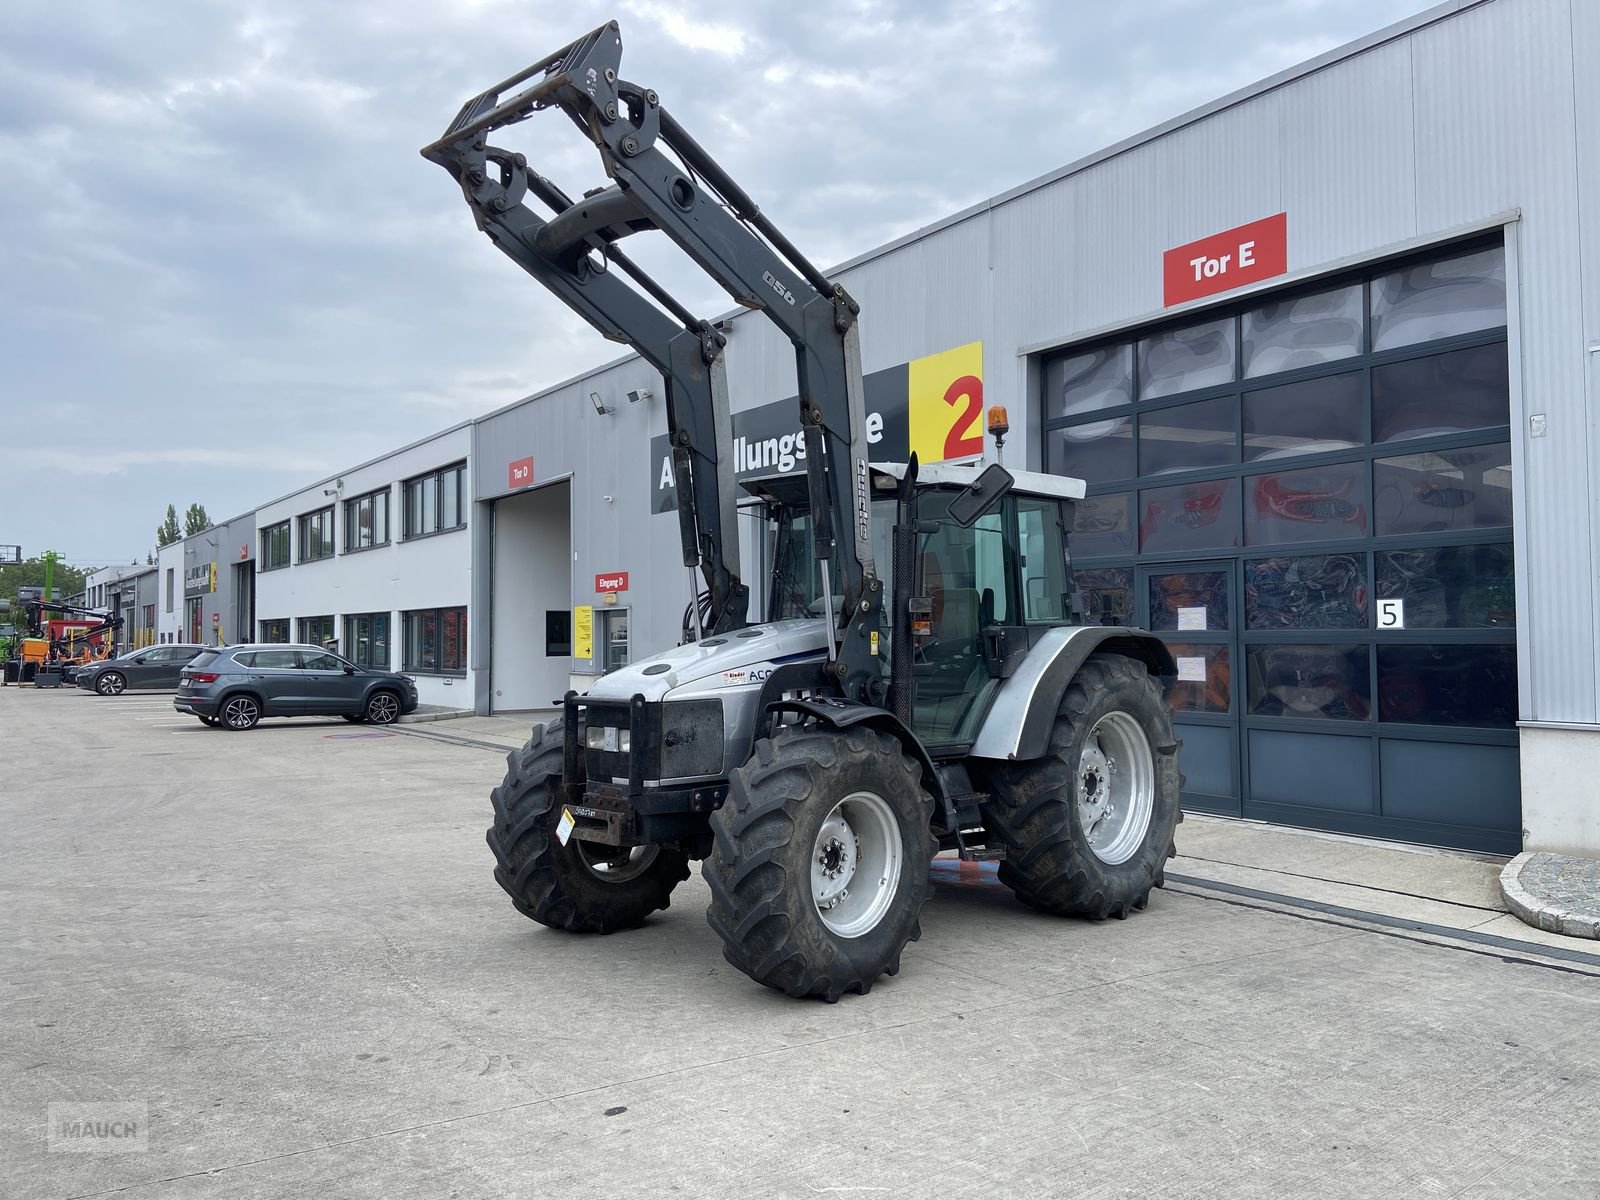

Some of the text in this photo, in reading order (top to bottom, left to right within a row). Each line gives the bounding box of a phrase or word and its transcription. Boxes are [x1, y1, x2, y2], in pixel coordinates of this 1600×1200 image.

[1190, 240, 1255, 282] Tor E
[943, 375, 984, 461] 2
[513, 465, 528, 480] Tor D
[600, 576, 624, 589] Eingang D
[1382, 603, 1397, 626] 5
